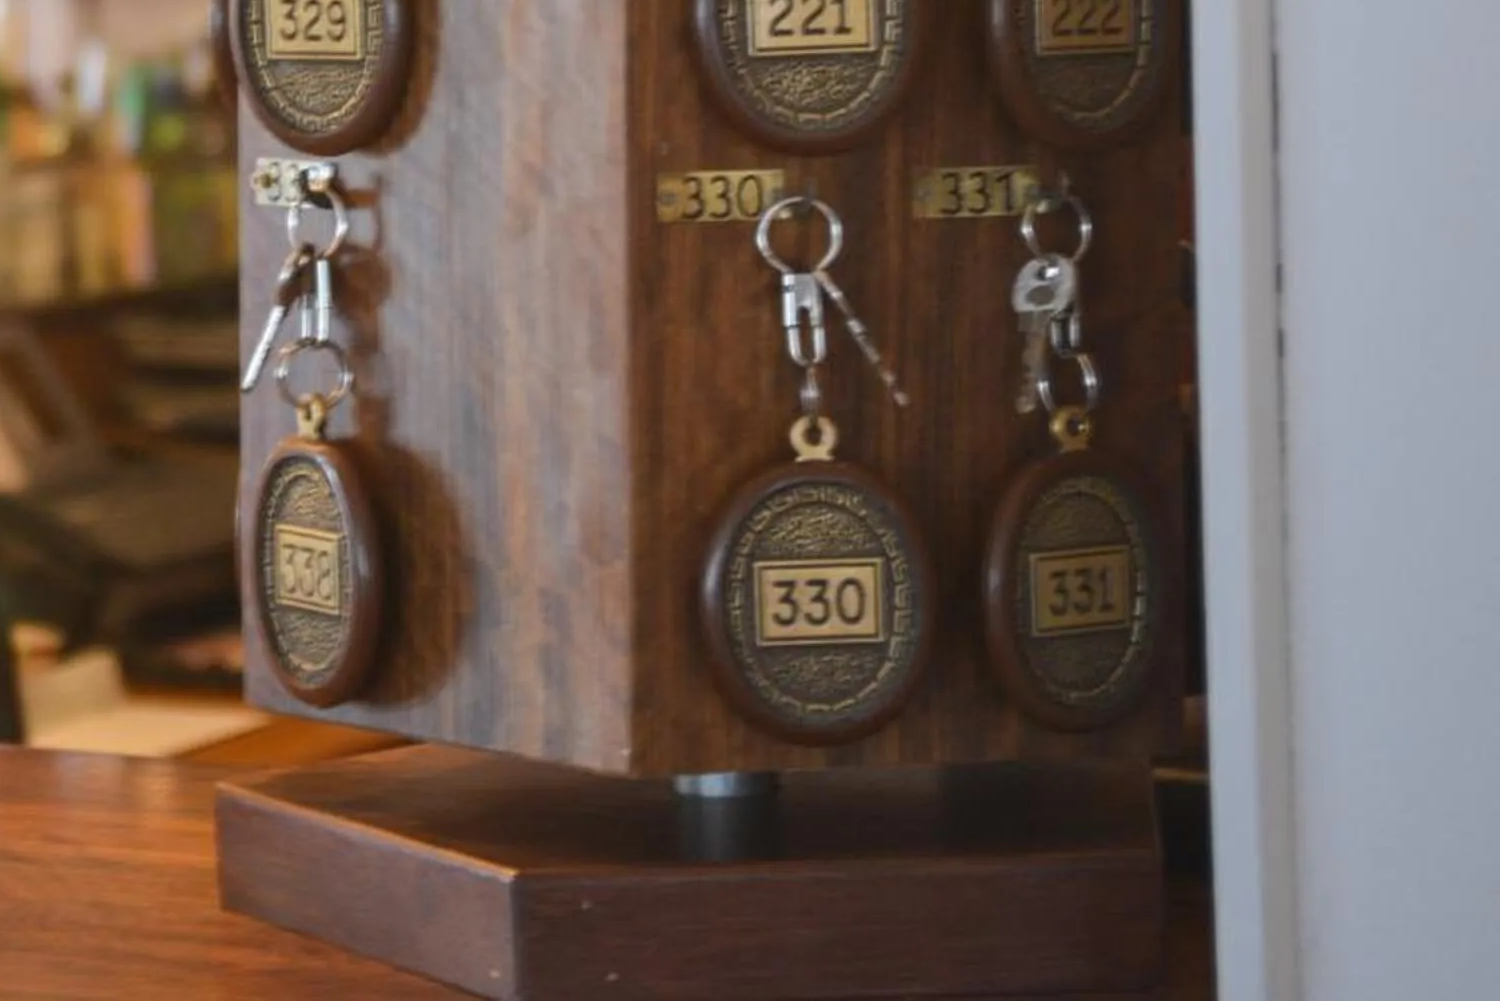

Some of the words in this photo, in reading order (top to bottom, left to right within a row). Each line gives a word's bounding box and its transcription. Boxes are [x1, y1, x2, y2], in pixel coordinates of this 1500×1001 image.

[681, 174, 762, 219] 330
[939, 171, 1015, 213] 331
[772, 577, 866, 627] 330
[1049, 566, 1115, 616] 331
